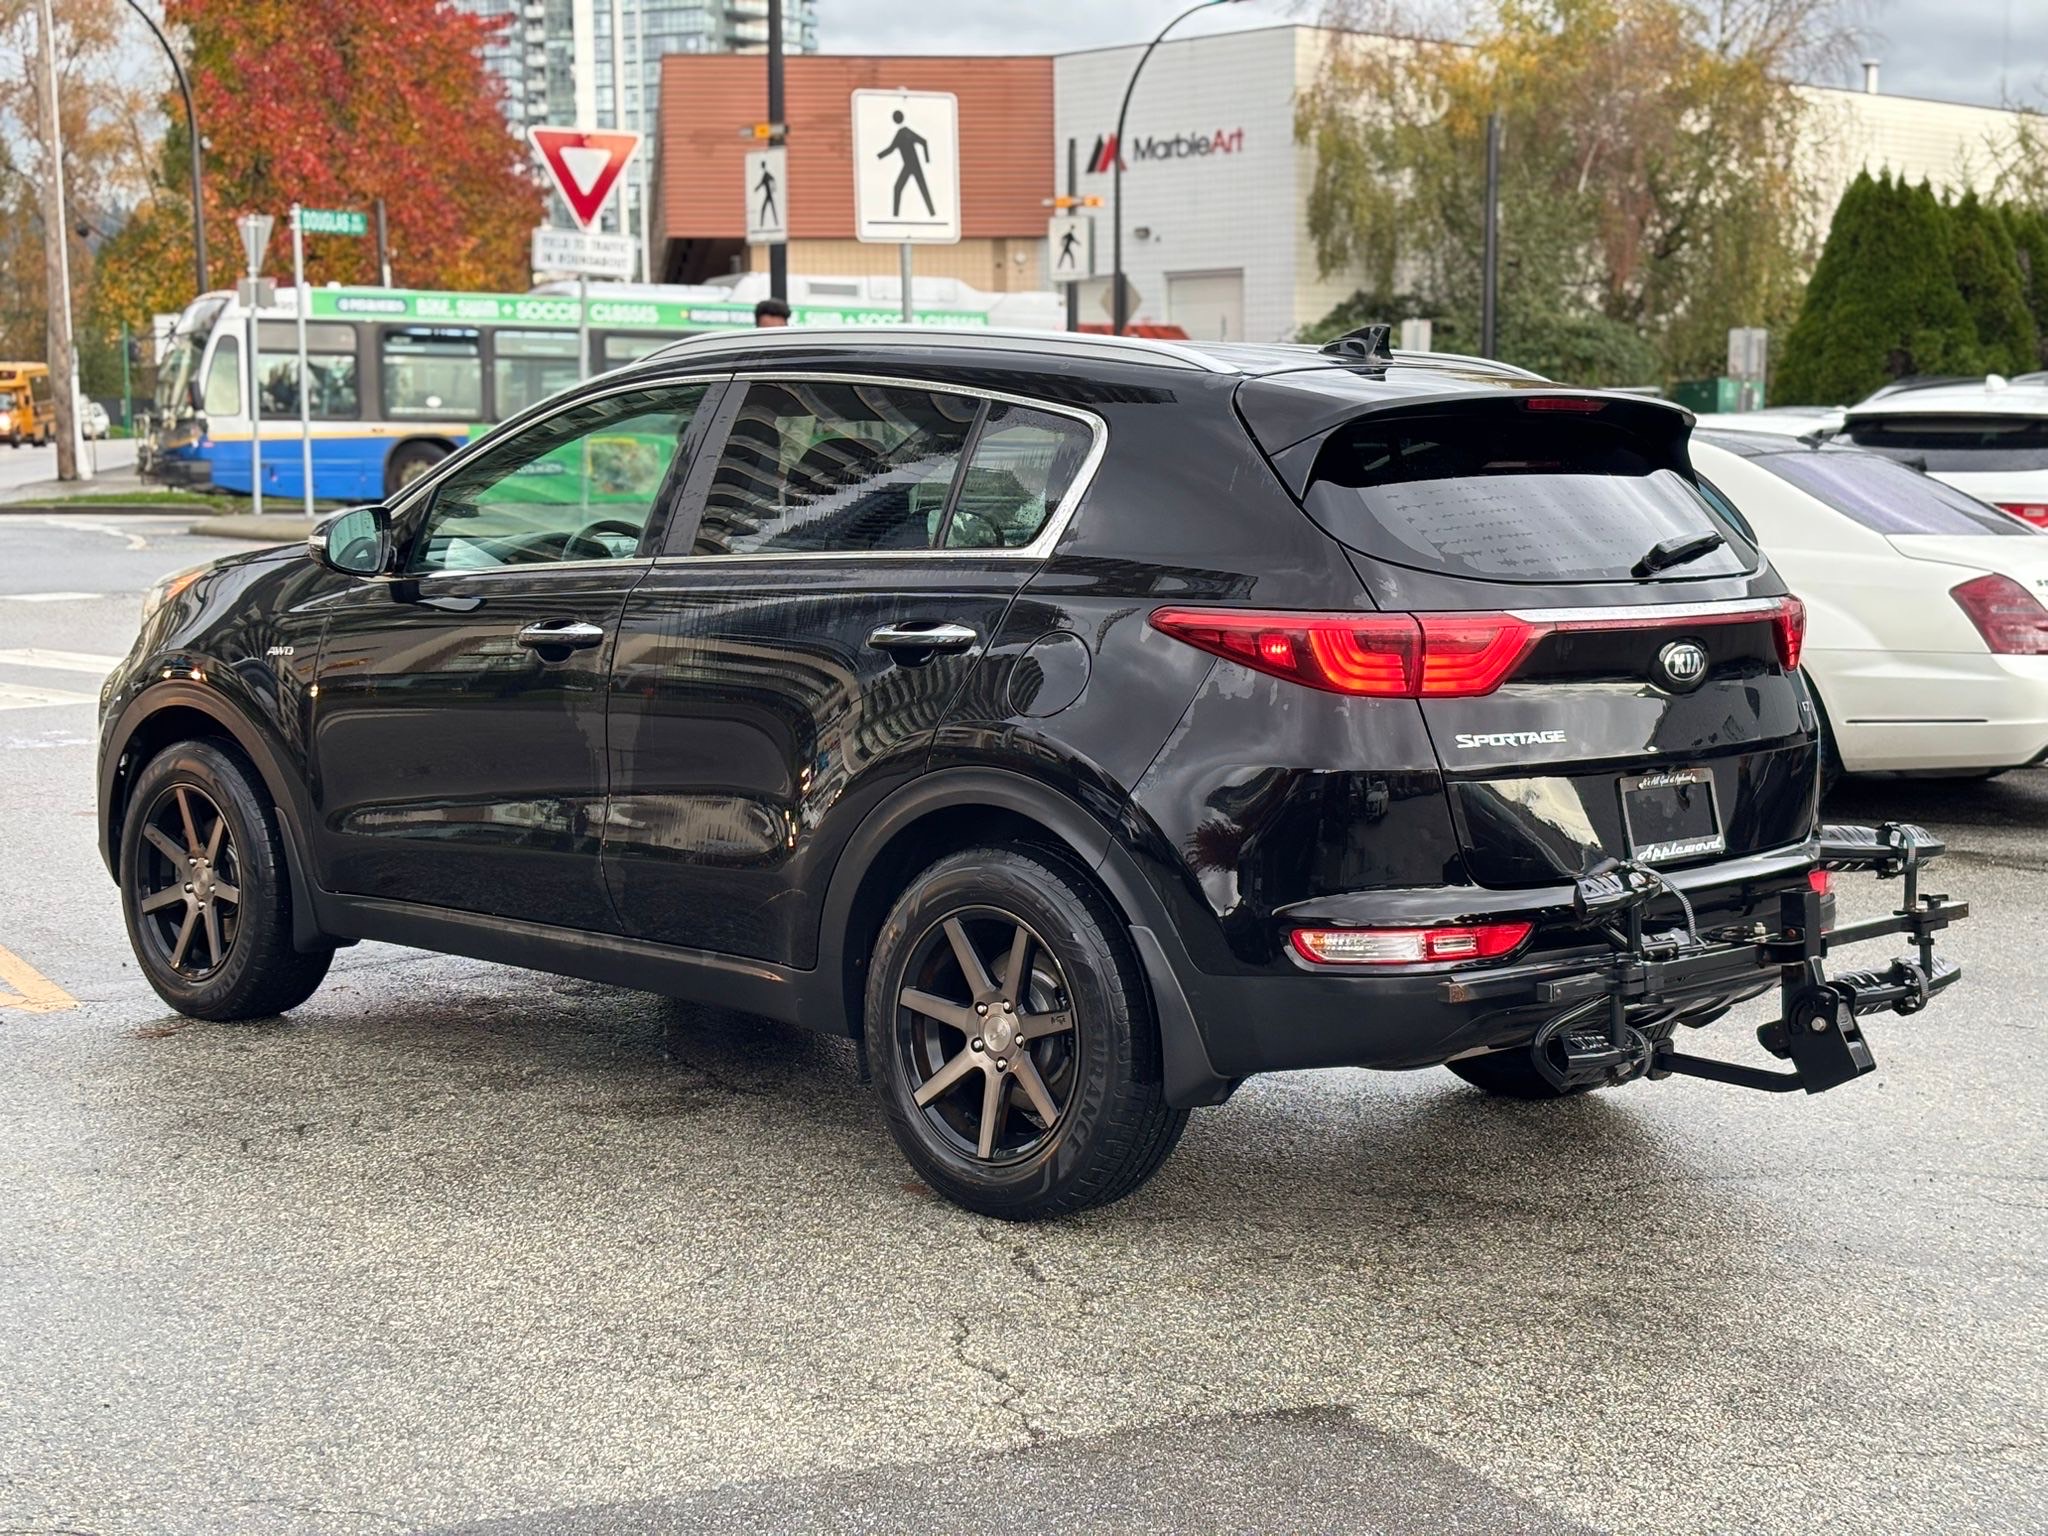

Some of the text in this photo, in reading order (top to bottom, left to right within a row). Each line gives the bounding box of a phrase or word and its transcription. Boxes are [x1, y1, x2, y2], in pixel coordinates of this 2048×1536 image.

[1134, 127, 1245, 161] MarbleArt
[266, 646, 294, 656] AWD
[1673, 652, 1701, 674] KIA
[1455, 730, 1567, 748] SPORTAGE
[1637, 836, 1722, 861] Applewood
